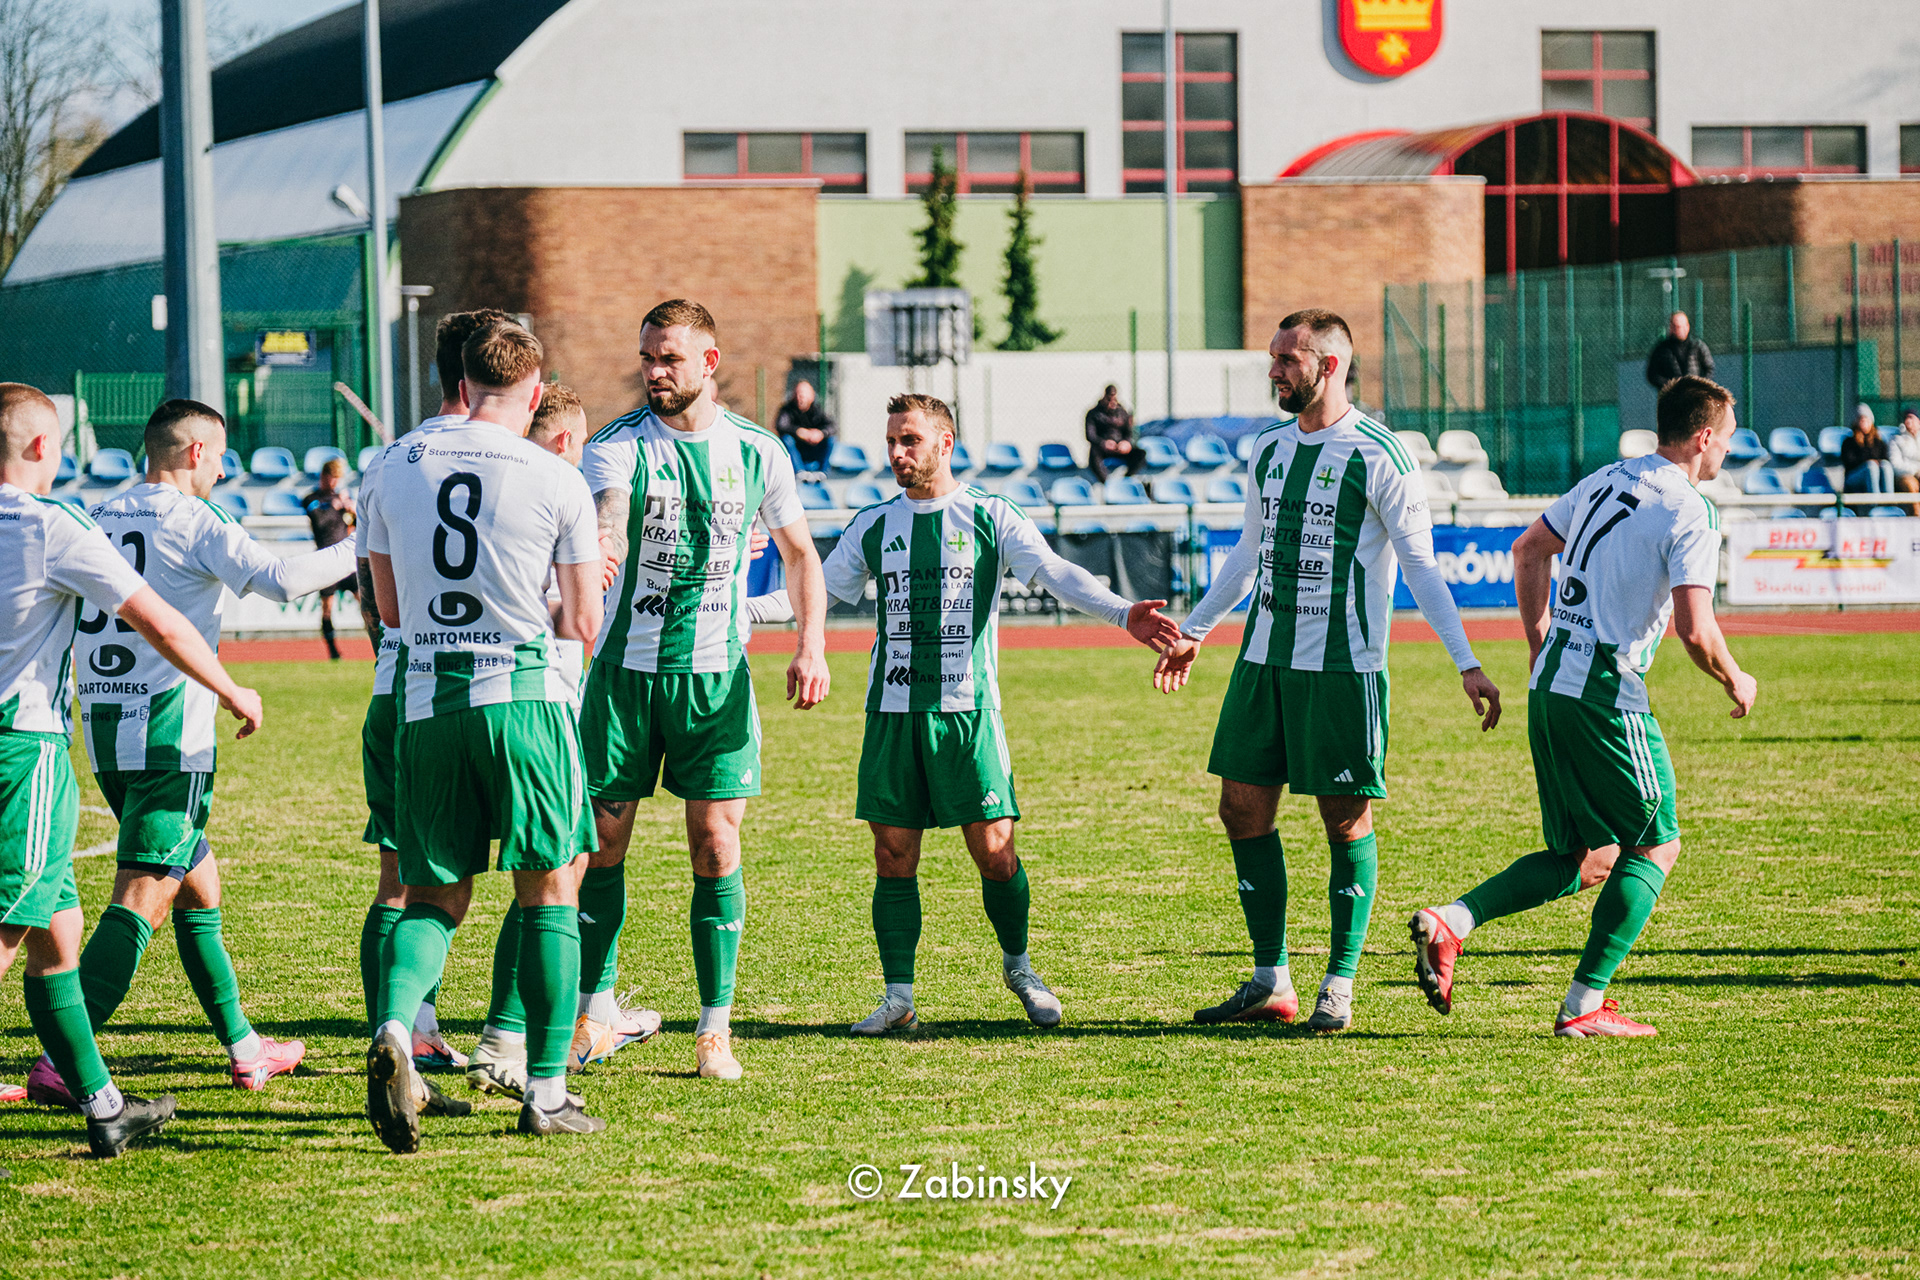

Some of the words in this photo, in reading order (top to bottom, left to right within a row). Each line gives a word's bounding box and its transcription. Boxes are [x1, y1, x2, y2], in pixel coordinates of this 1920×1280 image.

[428, 447, 482, 459] Starogard
[485, 451, 529, 465] Gdański
[1272, 497, 1336, 518] PANTOR
[432, 471, 483, 581] 8
[1311, 518, 1334, 527] LATA
[1566, 483, 1641, 573] 17
[1265, 526, 1333, 546] RAFT&DELE
[703, 560, 730, 572] KER
[1296, 559, 1324, 571] KER
[901, 566, 974, 582] PANTOR
[951, 581, 973, 590] LATA
[899, 620, 925, 632] BRO
[938, 625, 966, 635] KER
[415, 631, 501, 646] DARTOMEKS
[933, 649, 964, 659] nami!
[465, 657, 498, 669] KEBAB
[79, 682, 148, 696] DARTOMEKS
